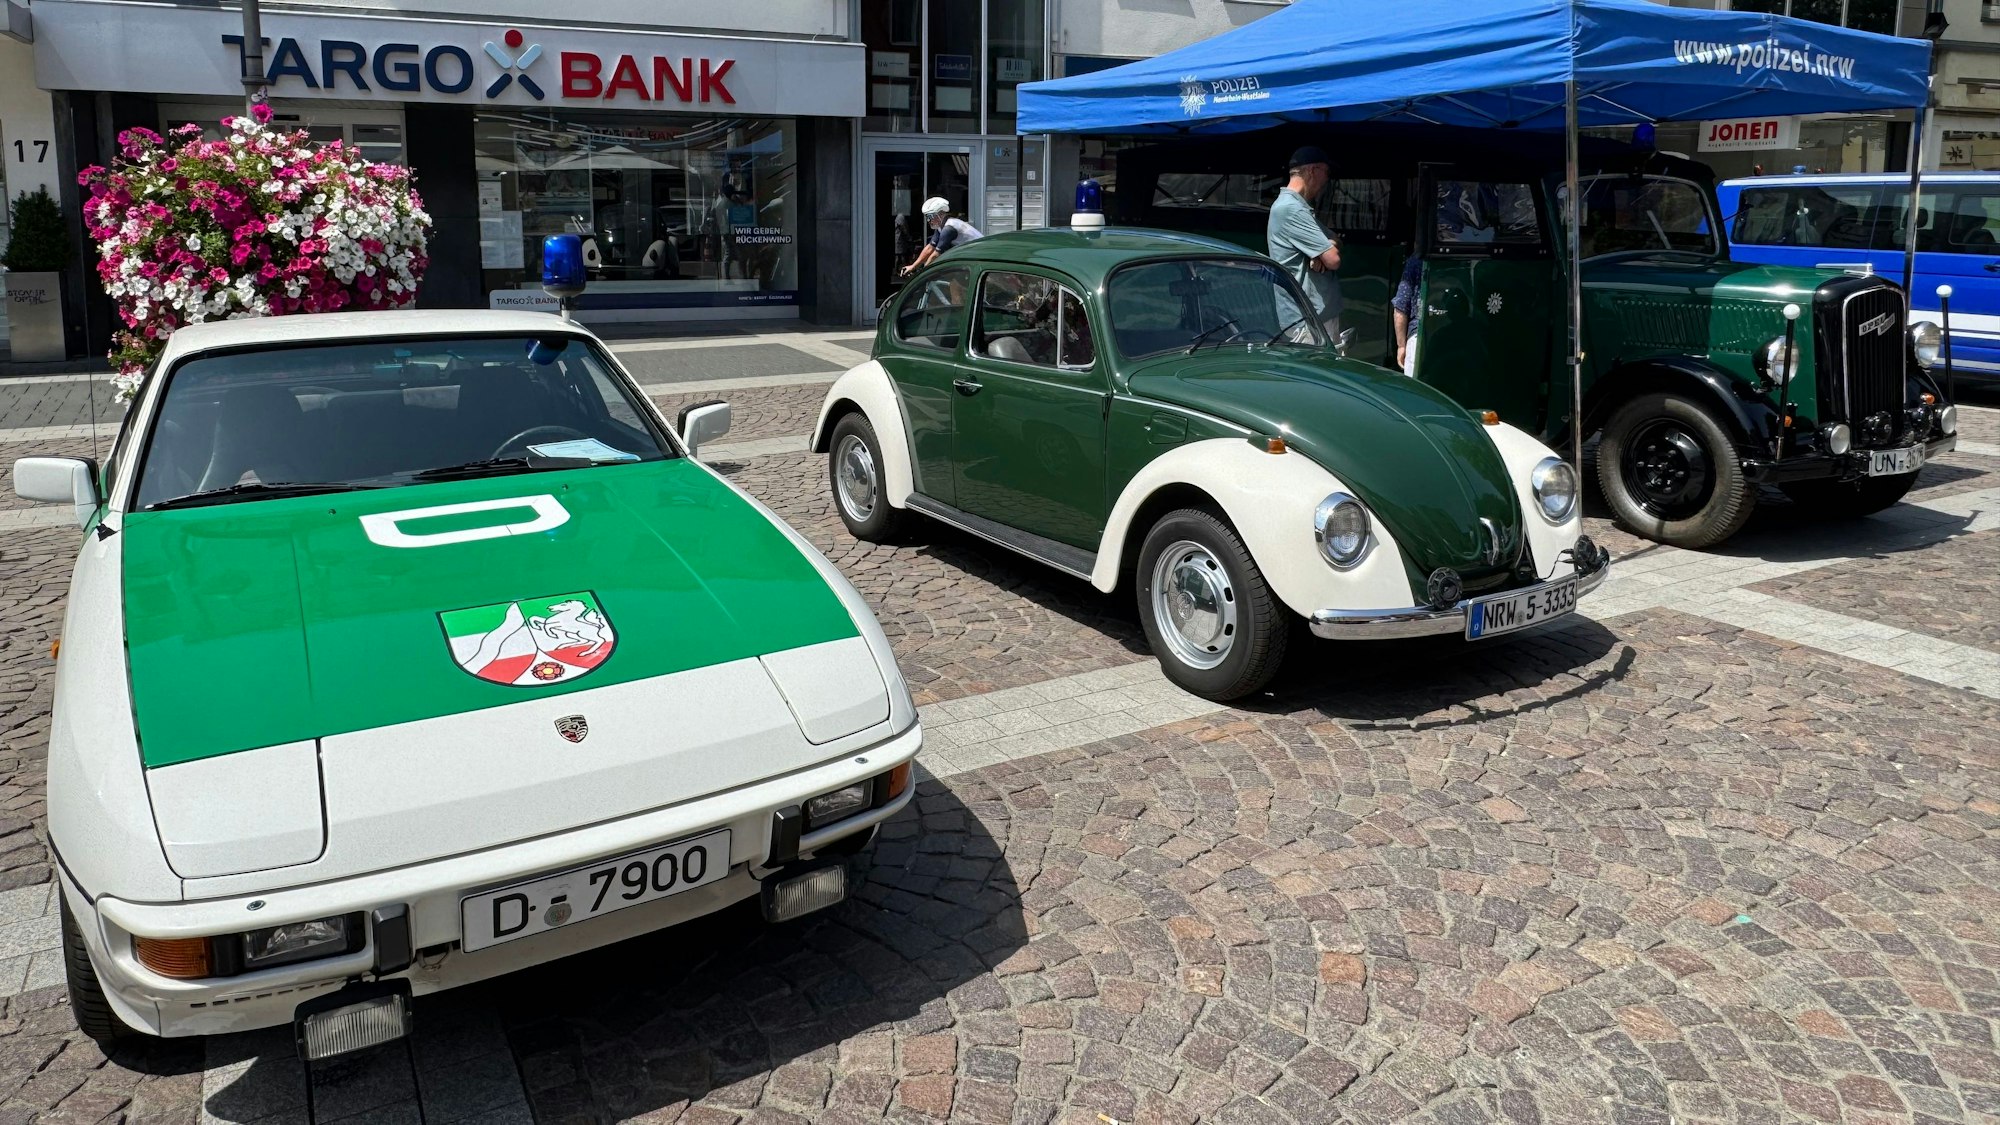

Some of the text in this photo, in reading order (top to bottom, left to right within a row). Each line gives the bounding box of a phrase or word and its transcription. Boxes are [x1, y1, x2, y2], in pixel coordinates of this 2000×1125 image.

[1674, 38, 1855, 79] www.polizei.nrw
[222, 35, 736, 104] TARGO BANK
[1211, 77, 1260, 94] POLIZEI
[1709, 121, 1778, 142] JONEN
[14, 139, 49, 163] 17
[735, 227, 781, 235] WIR GEBEN
[735, 235, 792, 244] RÜCKENWIND
[535, 297, 559, 305] BANK
[1875, 453, 1896, 472] UN
[1483, 582, 1575, 630] NRW 5-3333
[590, 845, 707, 913] 7900
